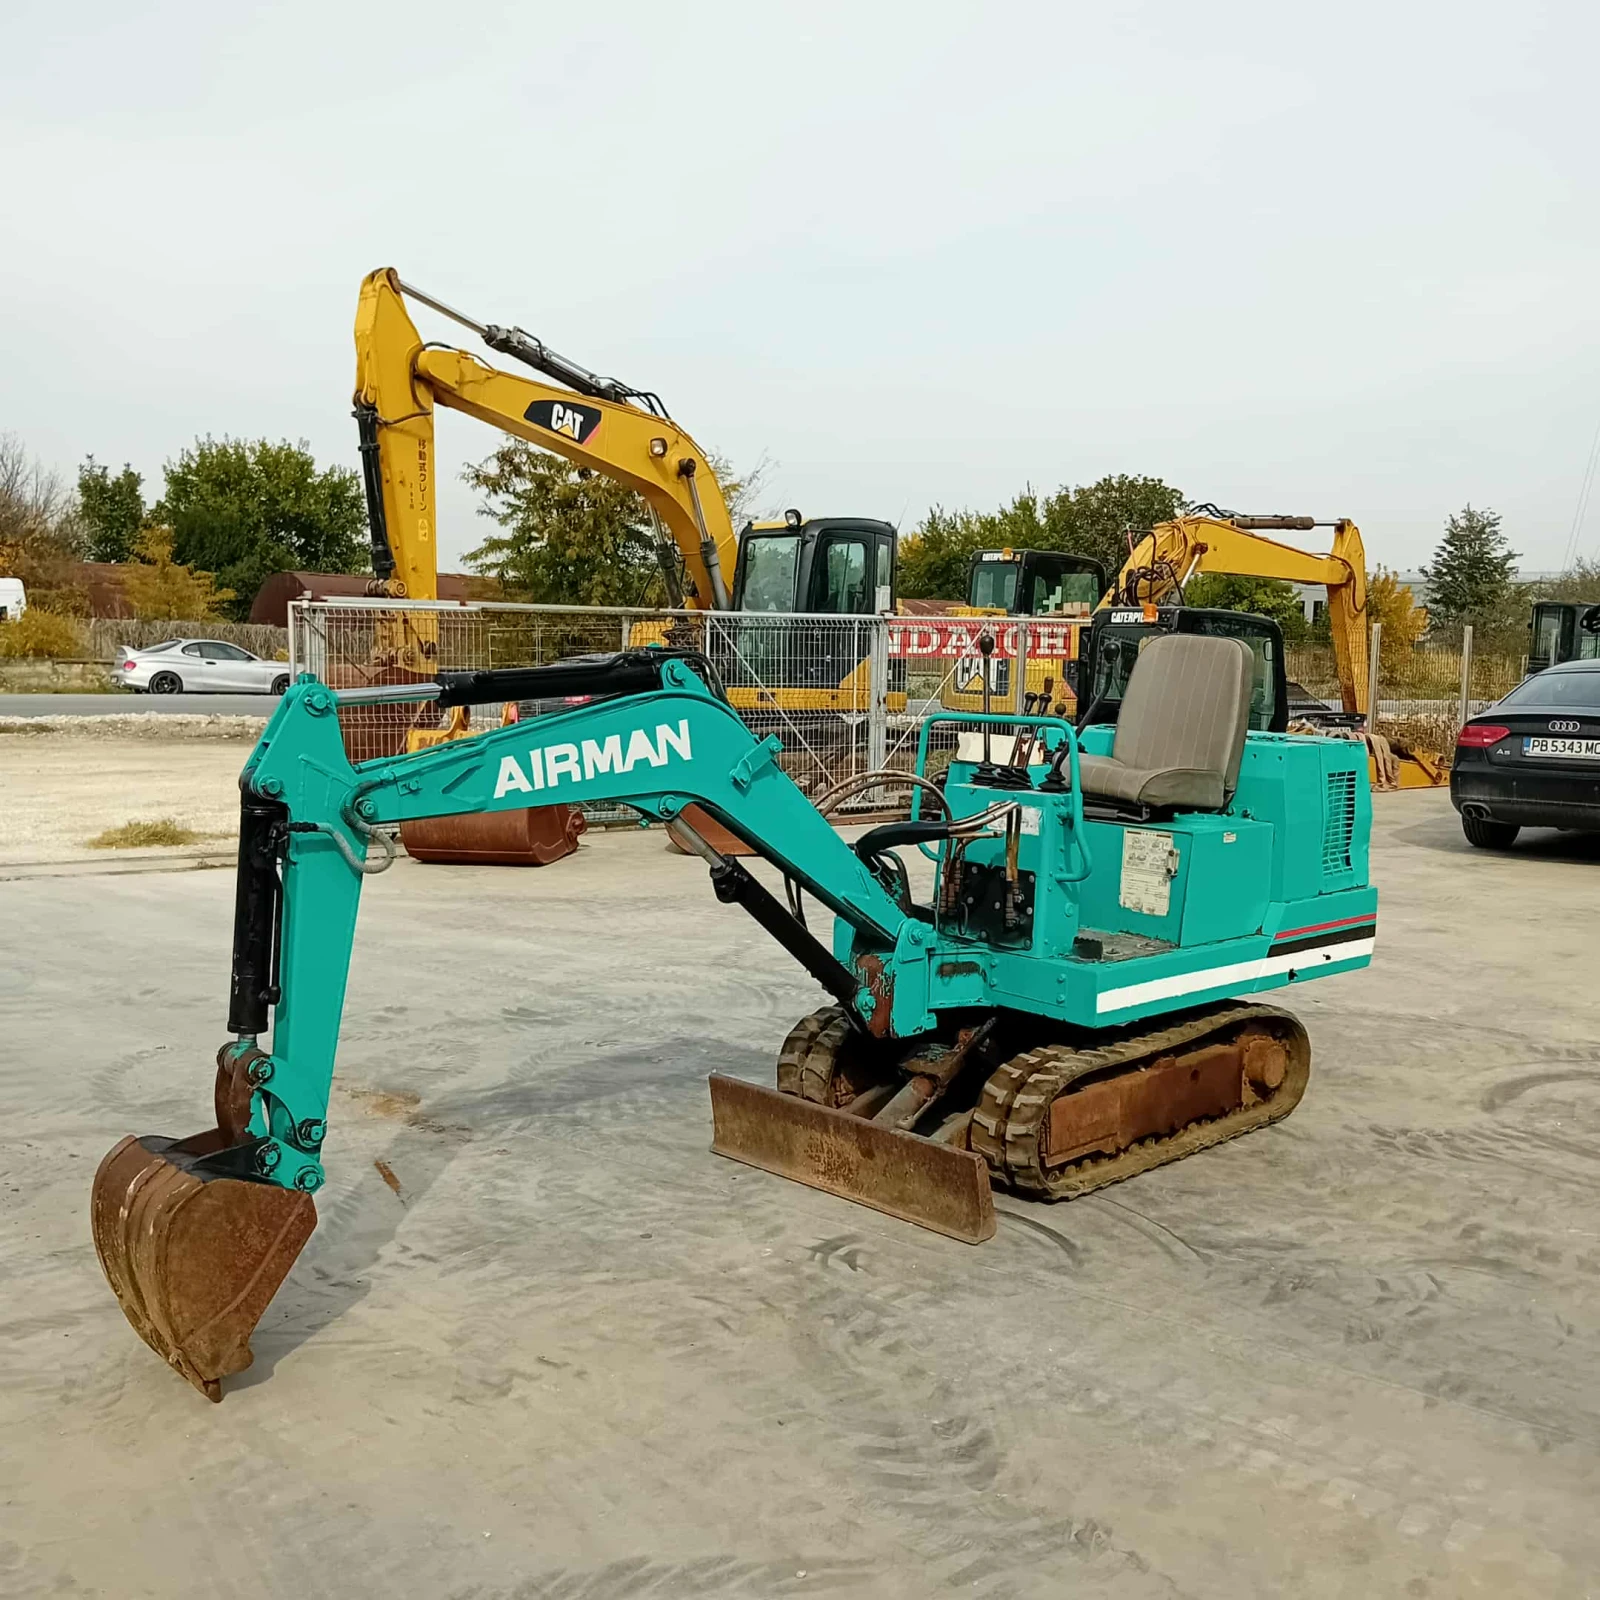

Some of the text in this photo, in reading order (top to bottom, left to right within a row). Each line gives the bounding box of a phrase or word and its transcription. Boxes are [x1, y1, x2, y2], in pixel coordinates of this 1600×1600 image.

[551, 403, 584, 440] CAT
[1111, 611, 1159, 623] CATERPIL
[493, 719, 693, 799] AIRMAN
[1551, 740, 1582, 754] 5343
